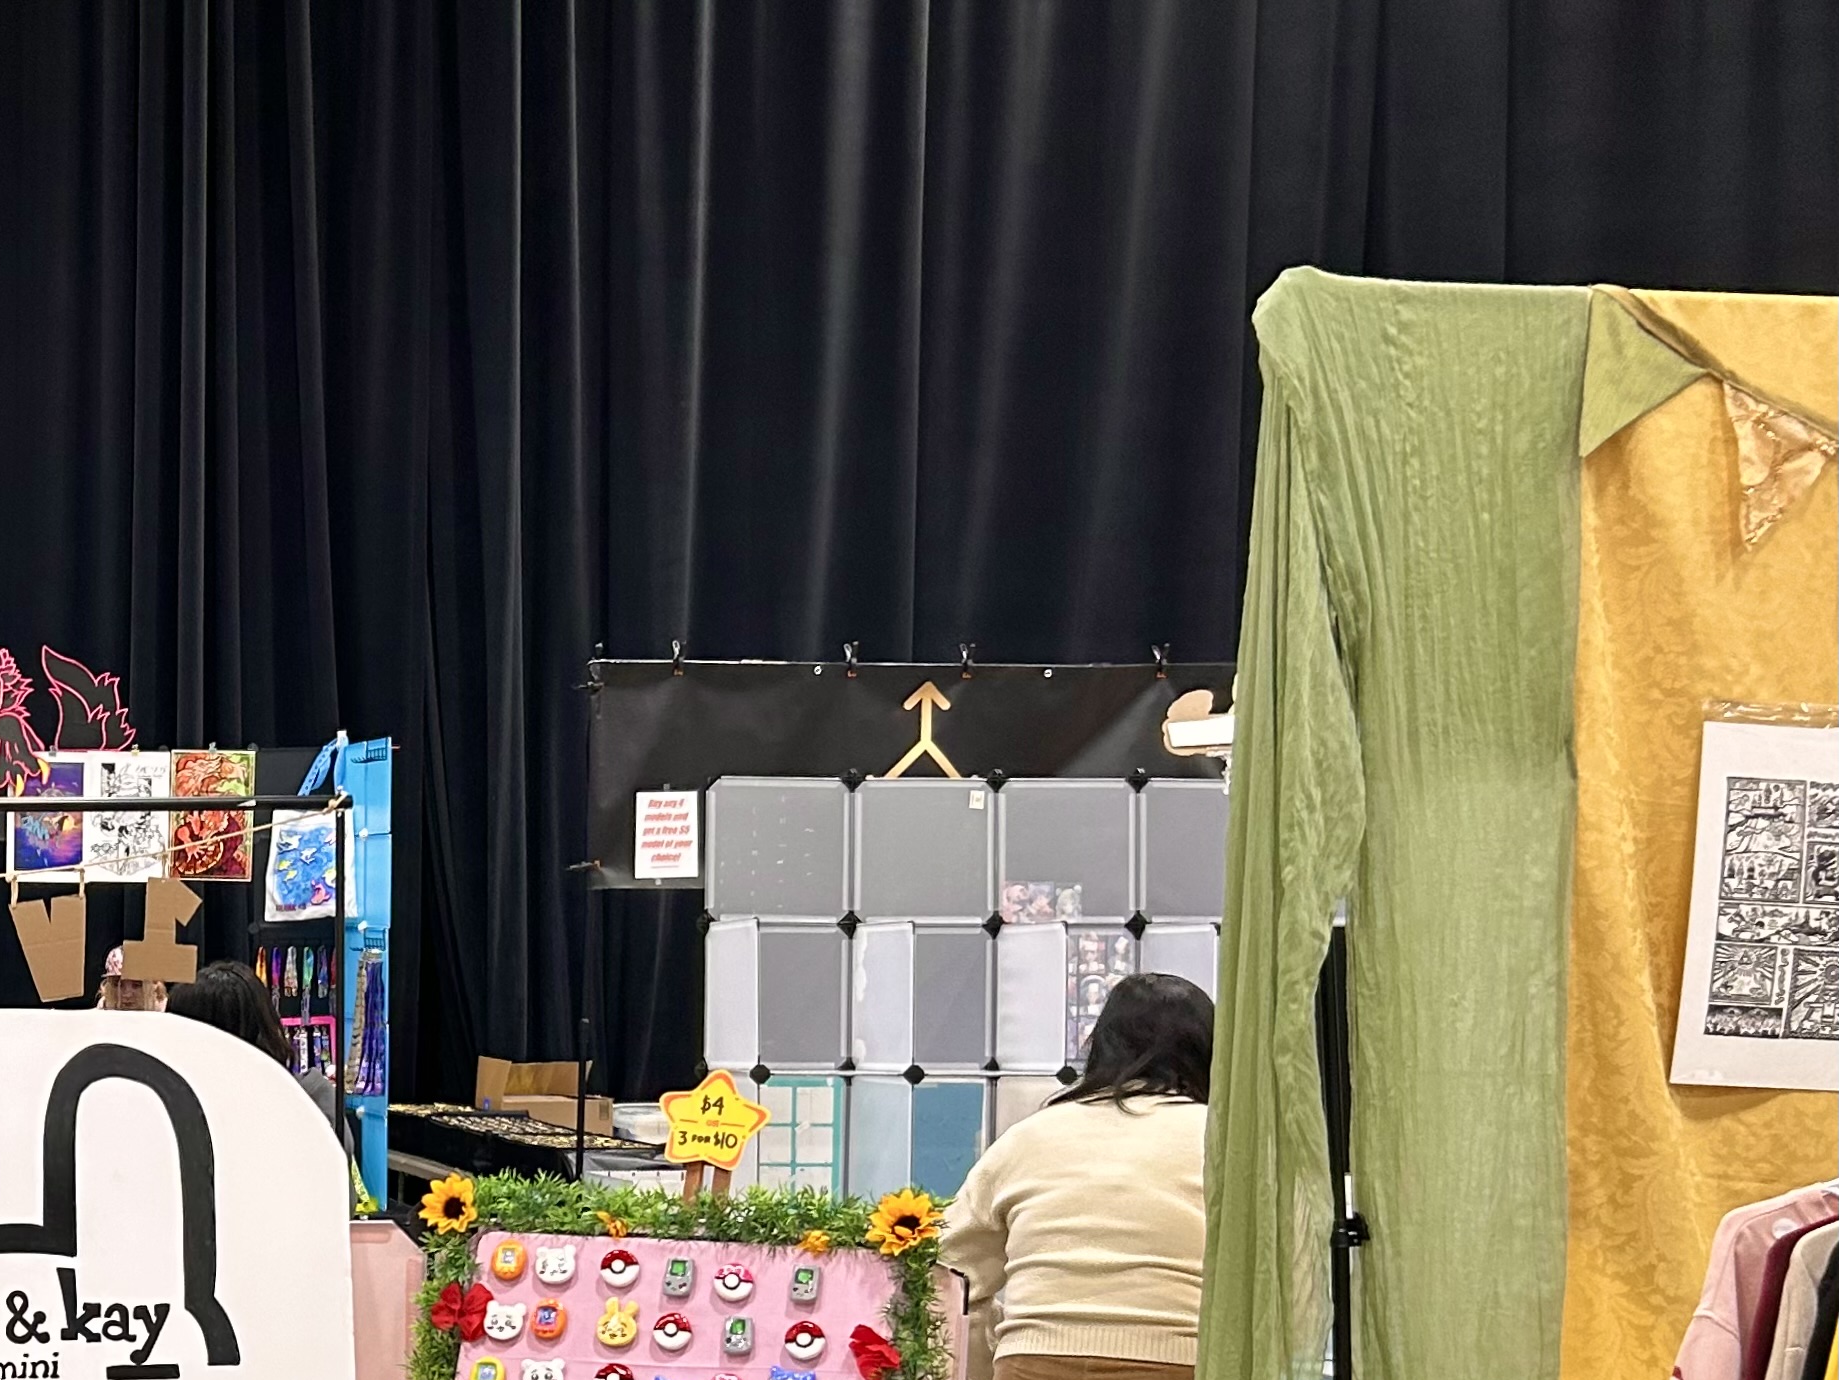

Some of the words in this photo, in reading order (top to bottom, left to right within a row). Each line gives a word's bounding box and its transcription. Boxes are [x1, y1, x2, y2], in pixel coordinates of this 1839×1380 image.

[700, 1094, 724, 1116] $4
[677, 1130, 688, 1146] 3
[691, 1134, 711, 1143] FOR
[713, 1131, 738, 1150] $10
[5, 1290, 51, 1345] &
[56, 1266, 171, 1365] kay
